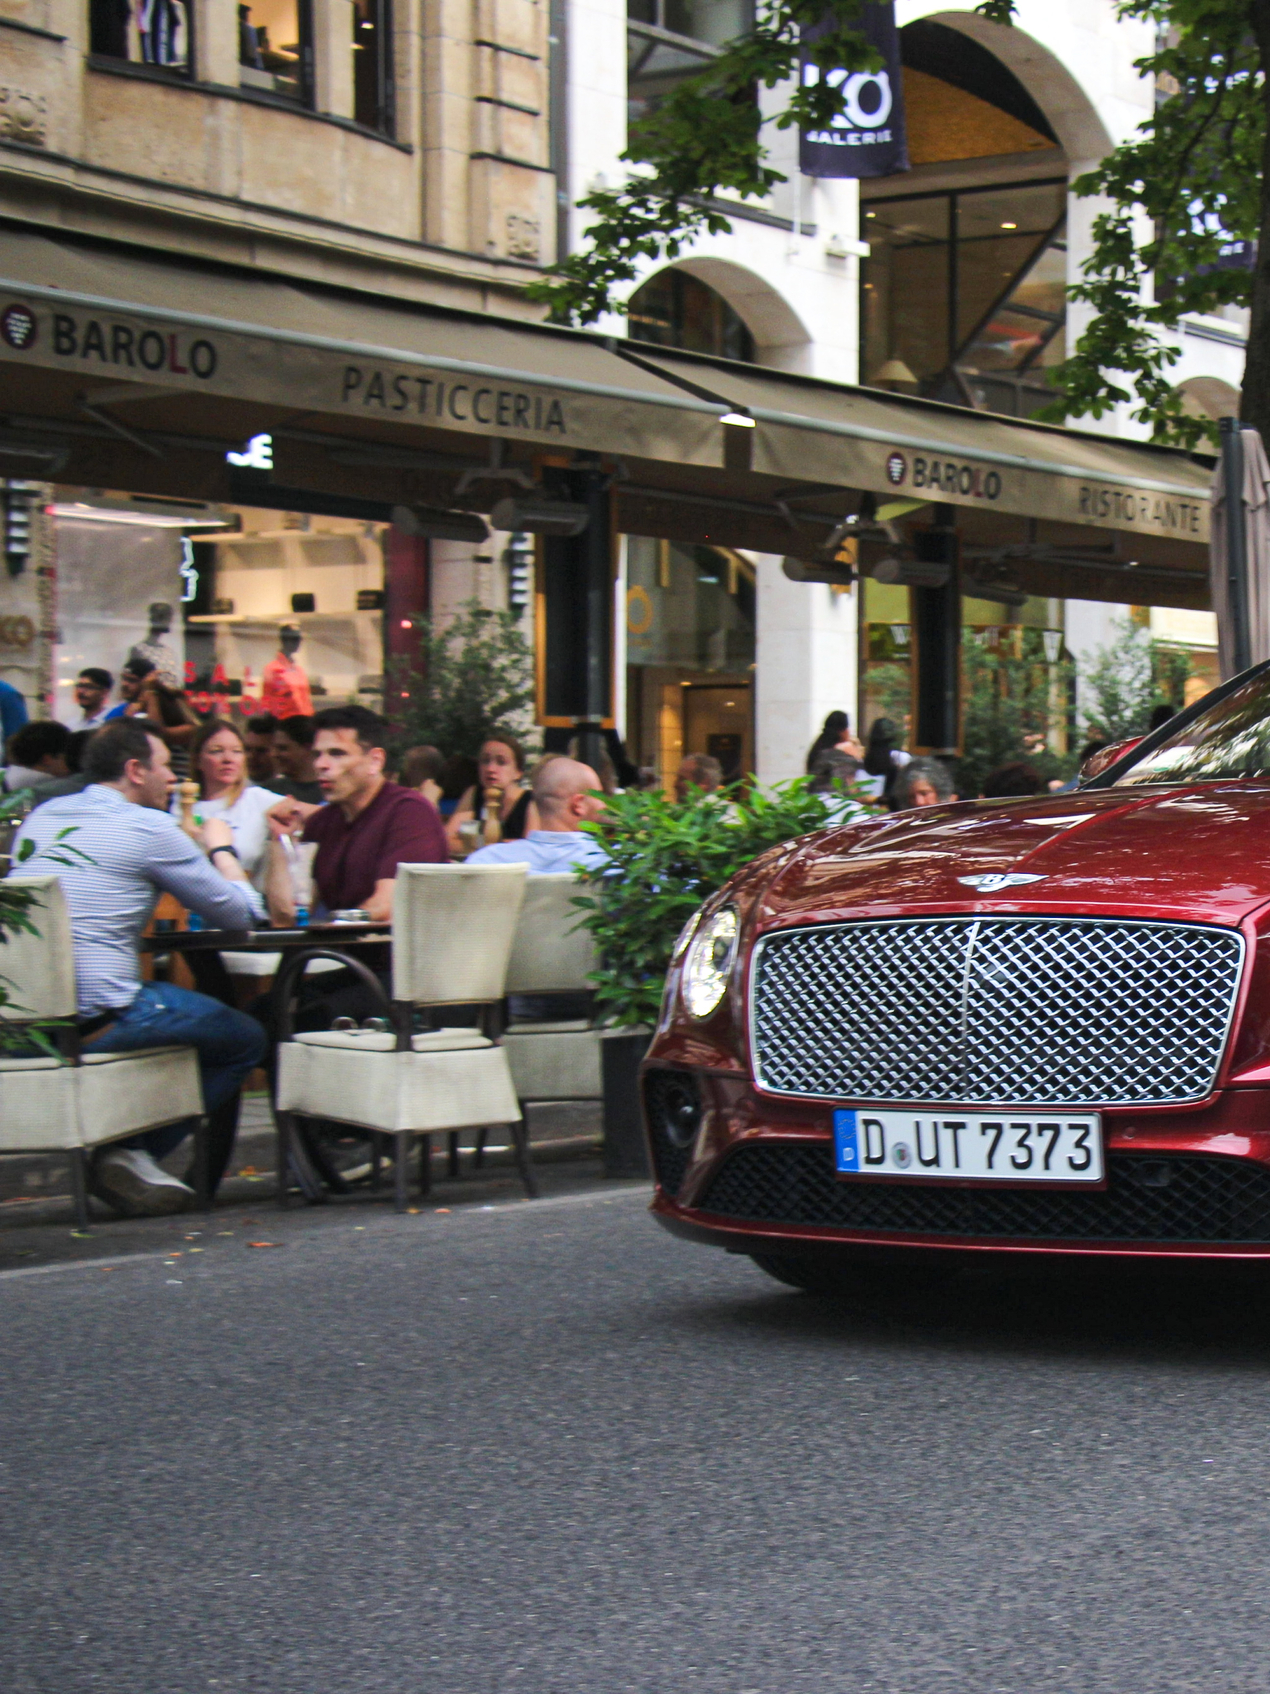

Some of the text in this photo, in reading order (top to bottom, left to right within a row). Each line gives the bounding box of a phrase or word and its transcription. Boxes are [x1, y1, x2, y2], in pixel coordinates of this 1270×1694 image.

[53, 313, 218, 380] BAROLO
[341, 366, 567, 435] PASTICCERIA
[912, 457, 1001, 500] BAROLO
[1078, 486, 1201, 533] RISTORANTE
[183, 661, 287, 690] SALE
[915, 1120, 968, 1168] UT
[980, 1121, 1093, 1171] 7373
